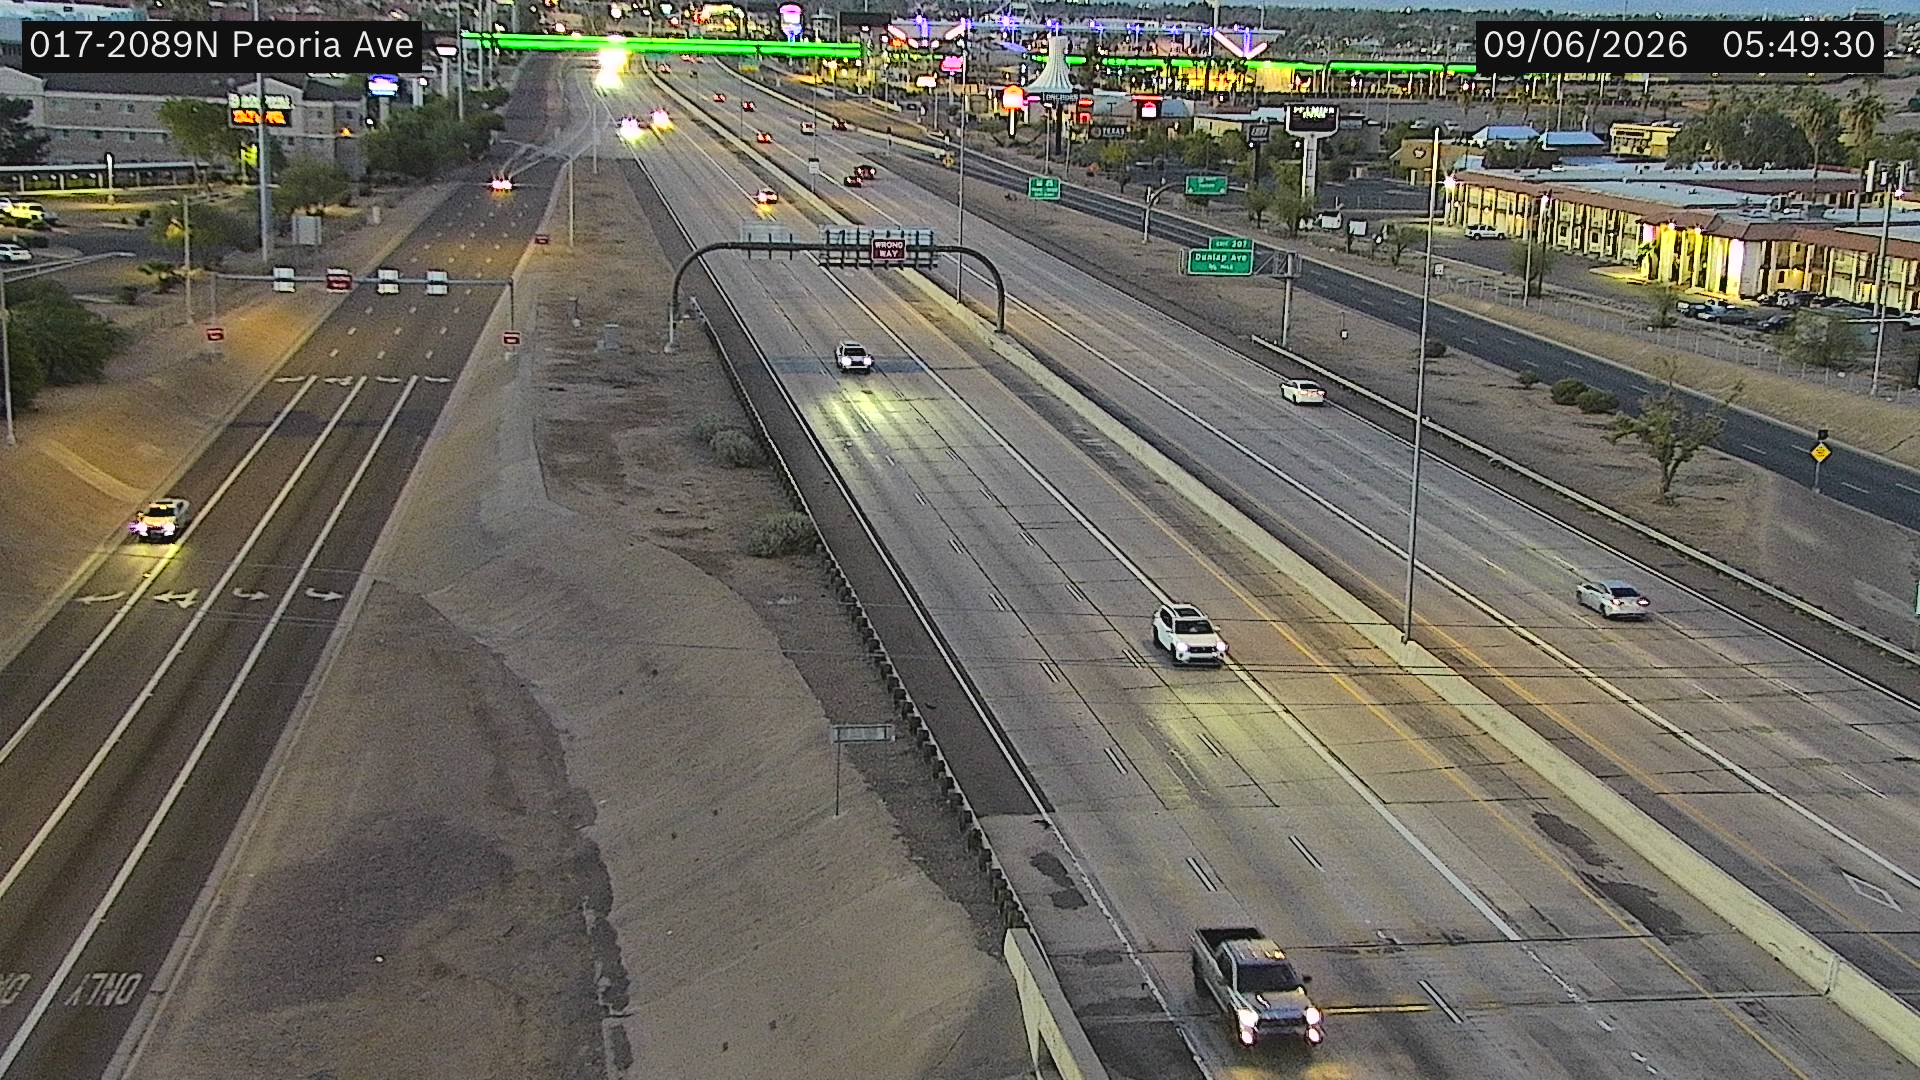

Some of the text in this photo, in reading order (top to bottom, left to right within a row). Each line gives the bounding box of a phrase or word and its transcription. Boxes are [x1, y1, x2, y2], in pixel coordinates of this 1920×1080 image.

[874, 241, 903, 249] WRONG
[1195, 253, 1227, 262] Dunlap
[63, 972, 144, 1007] ONLY
